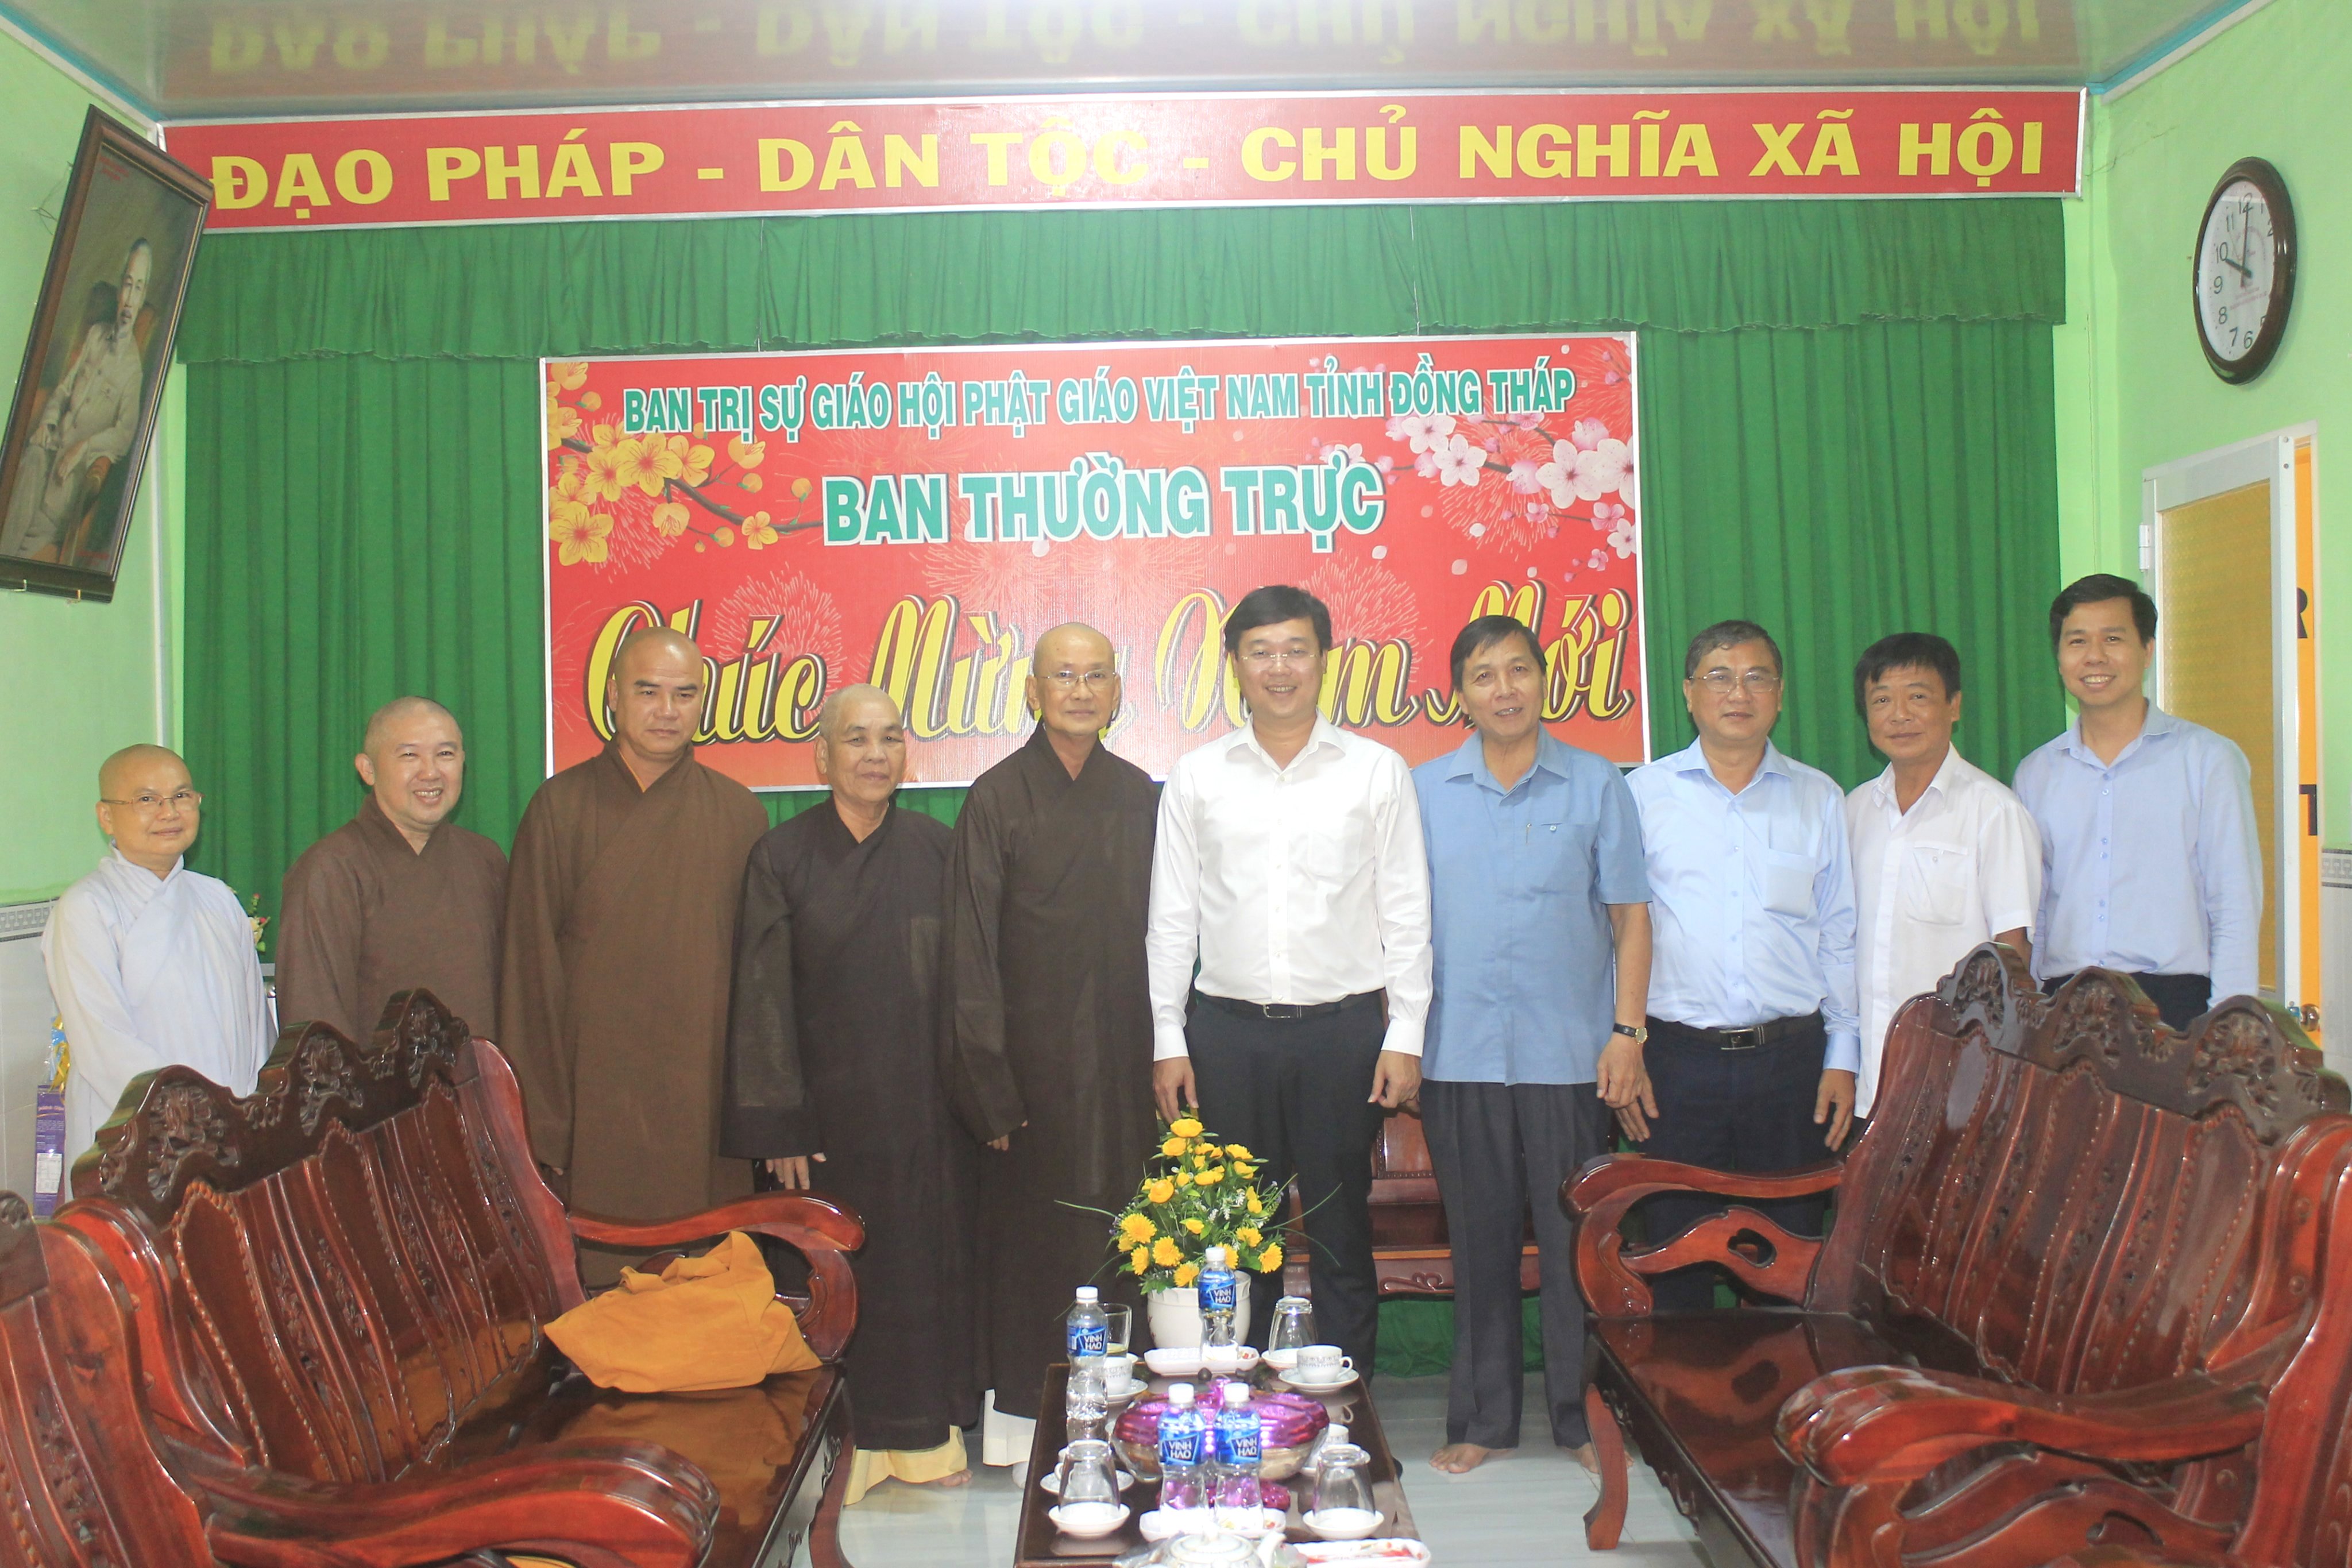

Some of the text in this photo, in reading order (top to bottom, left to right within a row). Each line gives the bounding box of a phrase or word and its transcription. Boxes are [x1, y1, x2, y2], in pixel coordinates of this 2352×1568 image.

[208, 104, 2044, 219] ĐẠO PHÁP - DÂN TỘC - CHỦ NGHĨA XÃ HỘI
[623, 352, 1577, 445] BAN TRỊ SỰ GIÁO HỘI PHẬT GIÁO VIỆT NAM TỈNH ĐỒNG THÁP
[822, 449, 1387, 554] BAN THƯỜNG TRỰC
[1154, 587, 1422, 732] Nm
